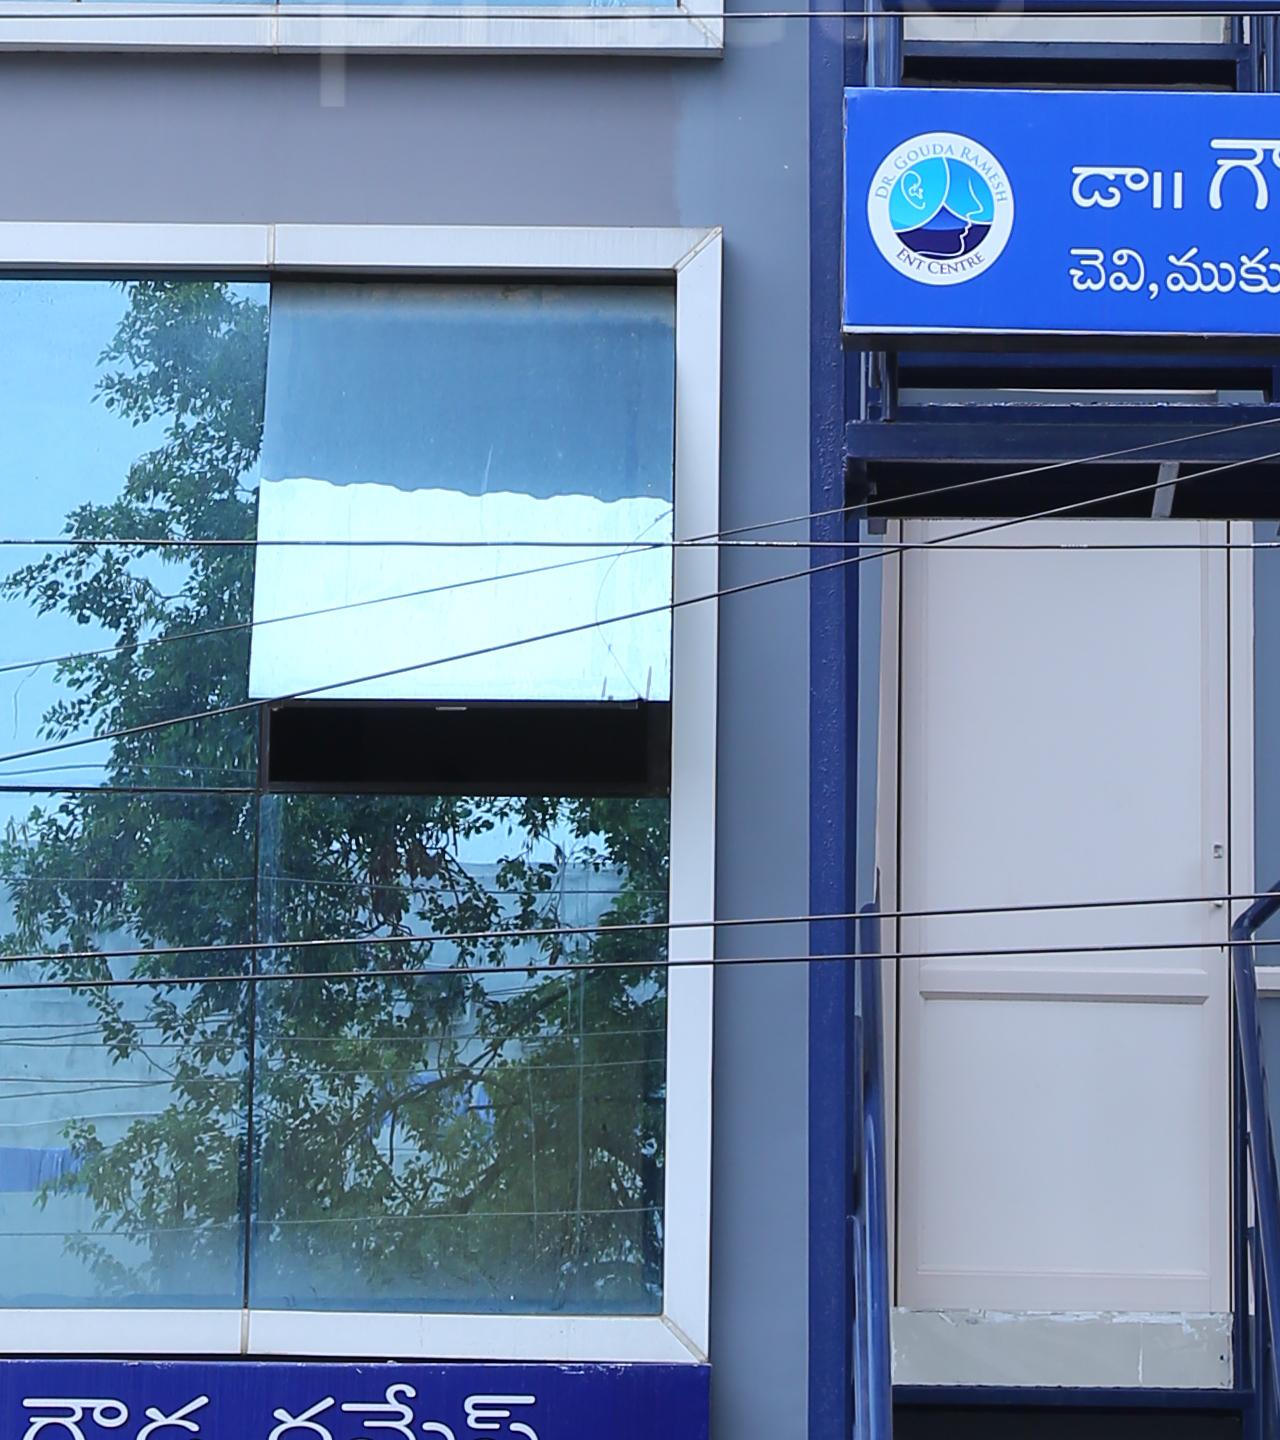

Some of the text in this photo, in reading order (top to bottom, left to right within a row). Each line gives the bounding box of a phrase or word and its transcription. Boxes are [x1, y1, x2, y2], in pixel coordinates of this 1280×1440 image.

[893, 143, 955, 171] GOUDA
[960, 145, 1008, 203] RAMESH
[896, 247, 986, 275] ENT CENTRE
